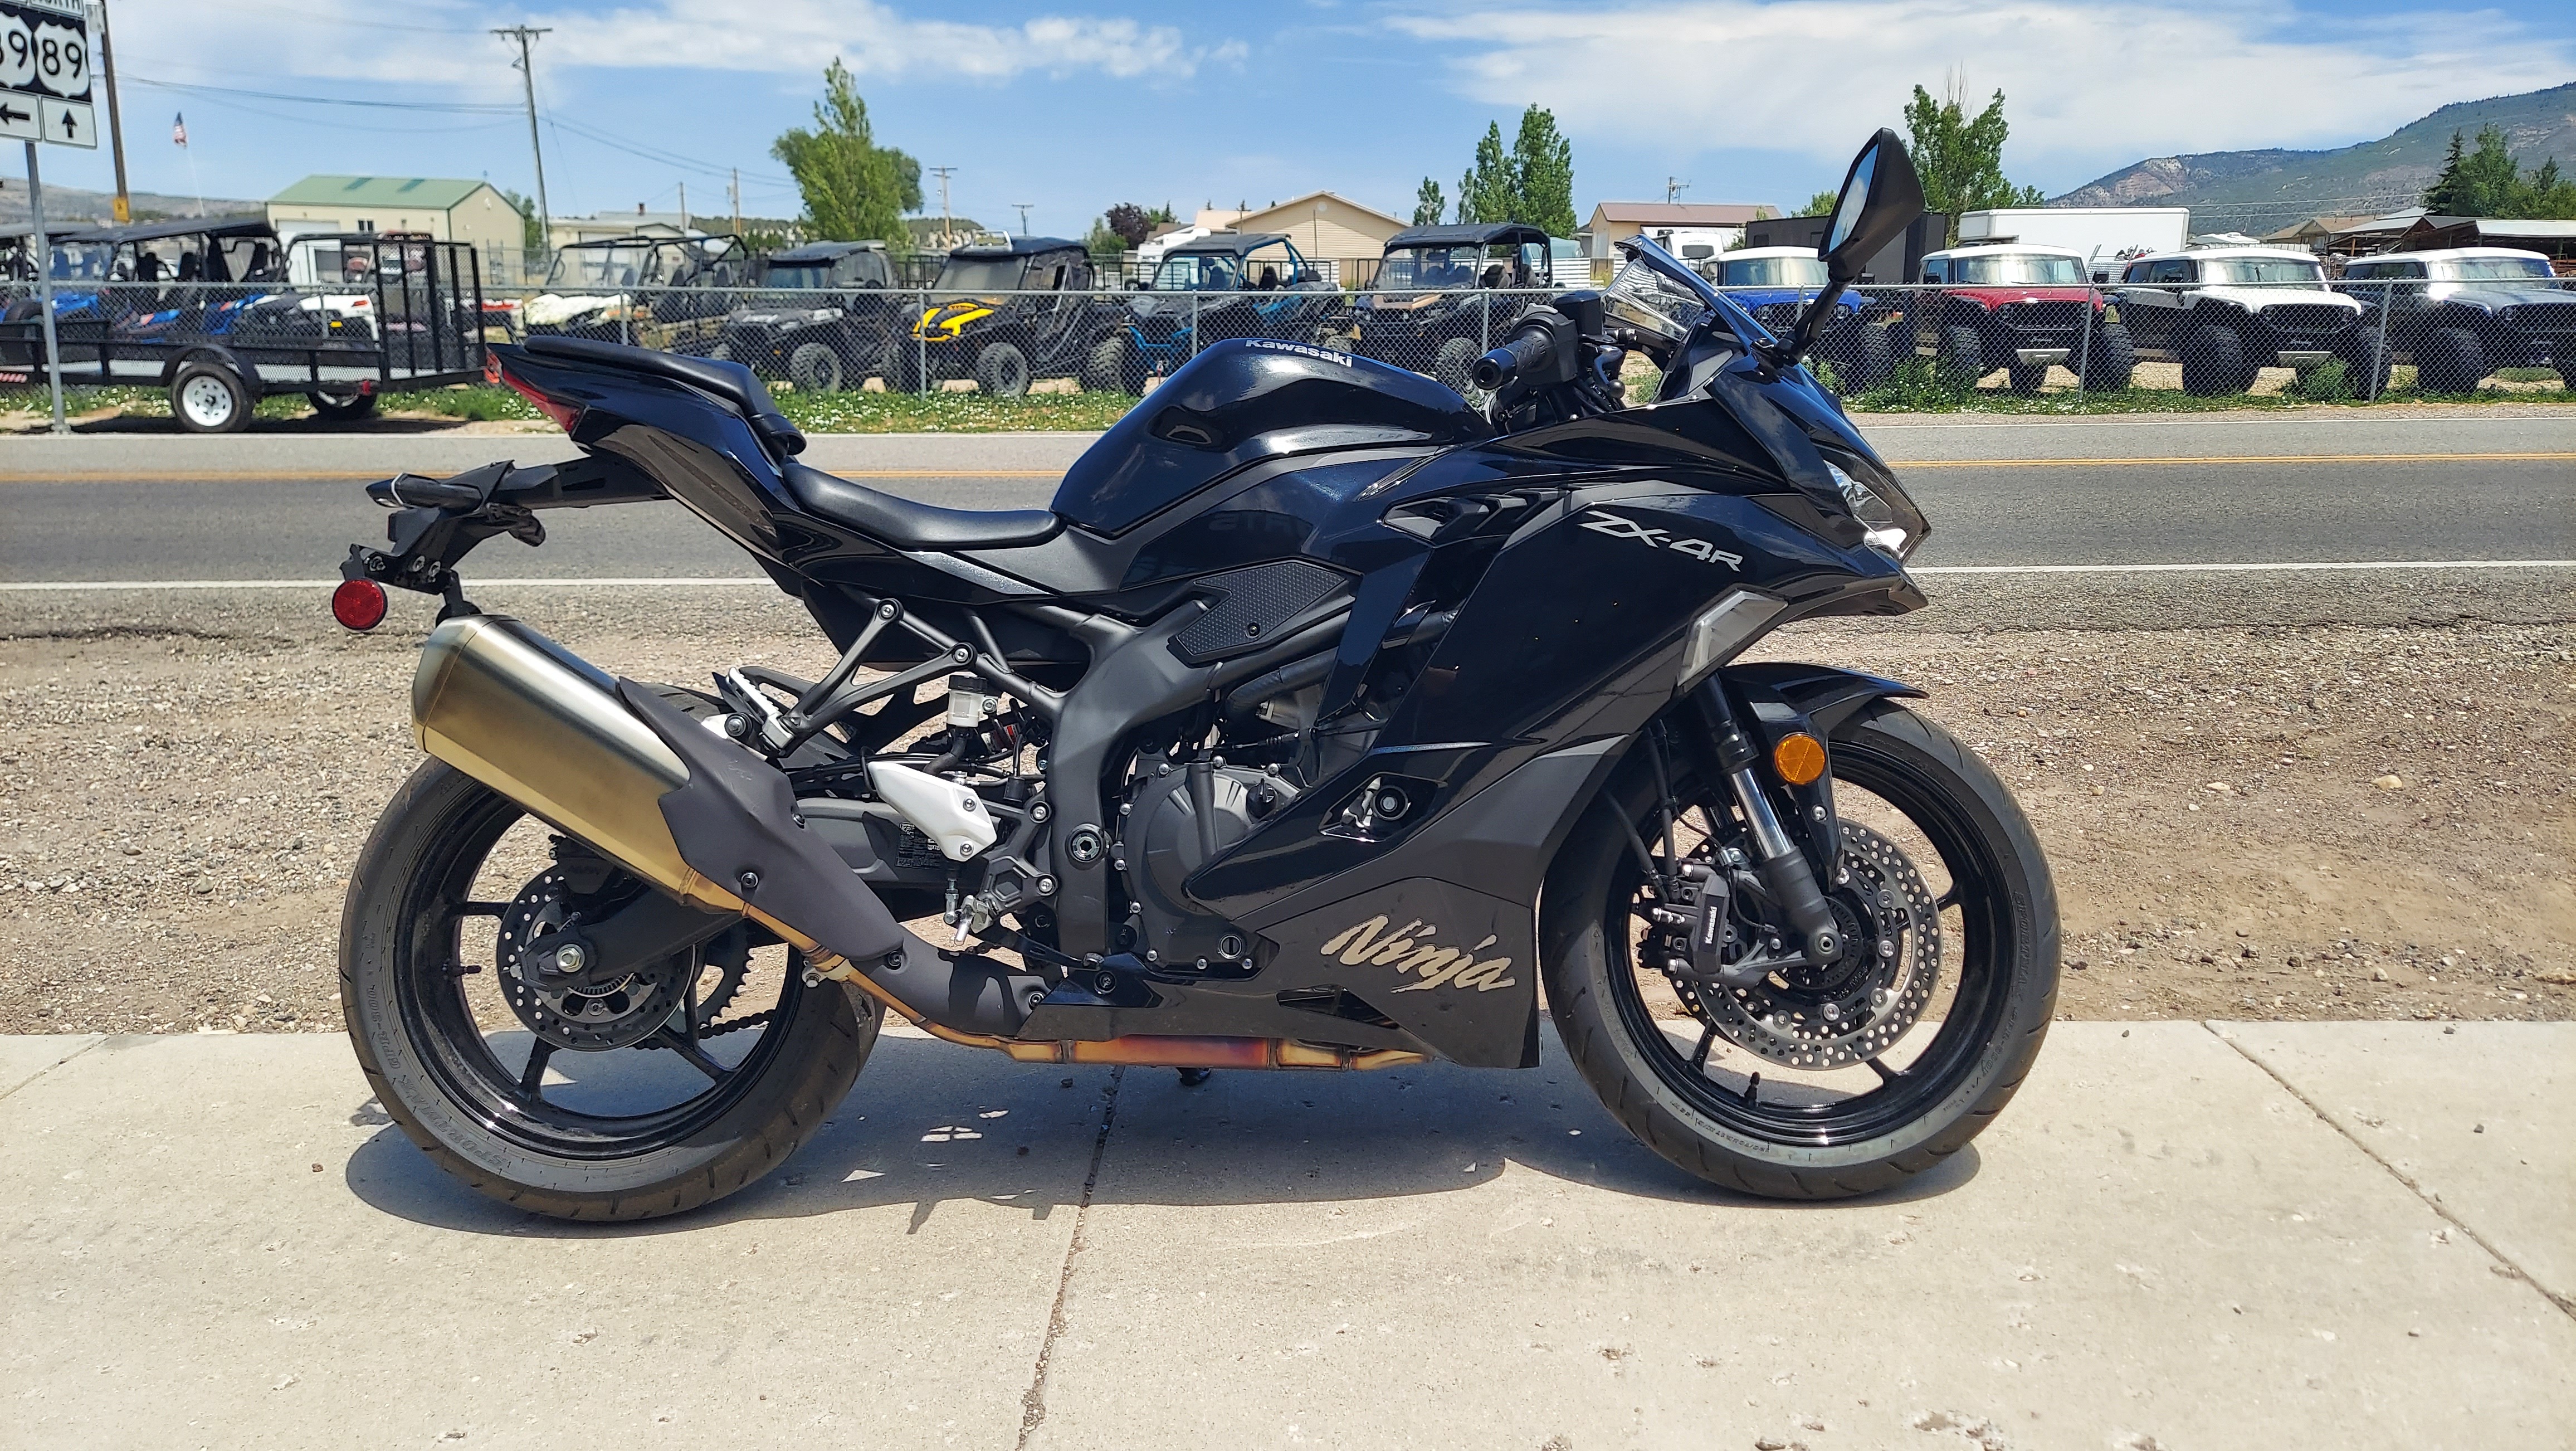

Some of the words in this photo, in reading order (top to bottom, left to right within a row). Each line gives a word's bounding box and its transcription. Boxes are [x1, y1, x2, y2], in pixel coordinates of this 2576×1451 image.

[0, 30, 27, 68] 9
[42, 39, 82, 79] 89
[1245, 339, 1353, 368] Kawasaki
[1577, 510, 1743, 572] ZX-4R
[1705, 906, 1718, 944] Kawasaki
[1320, 914, 1516, 993] Ninja
